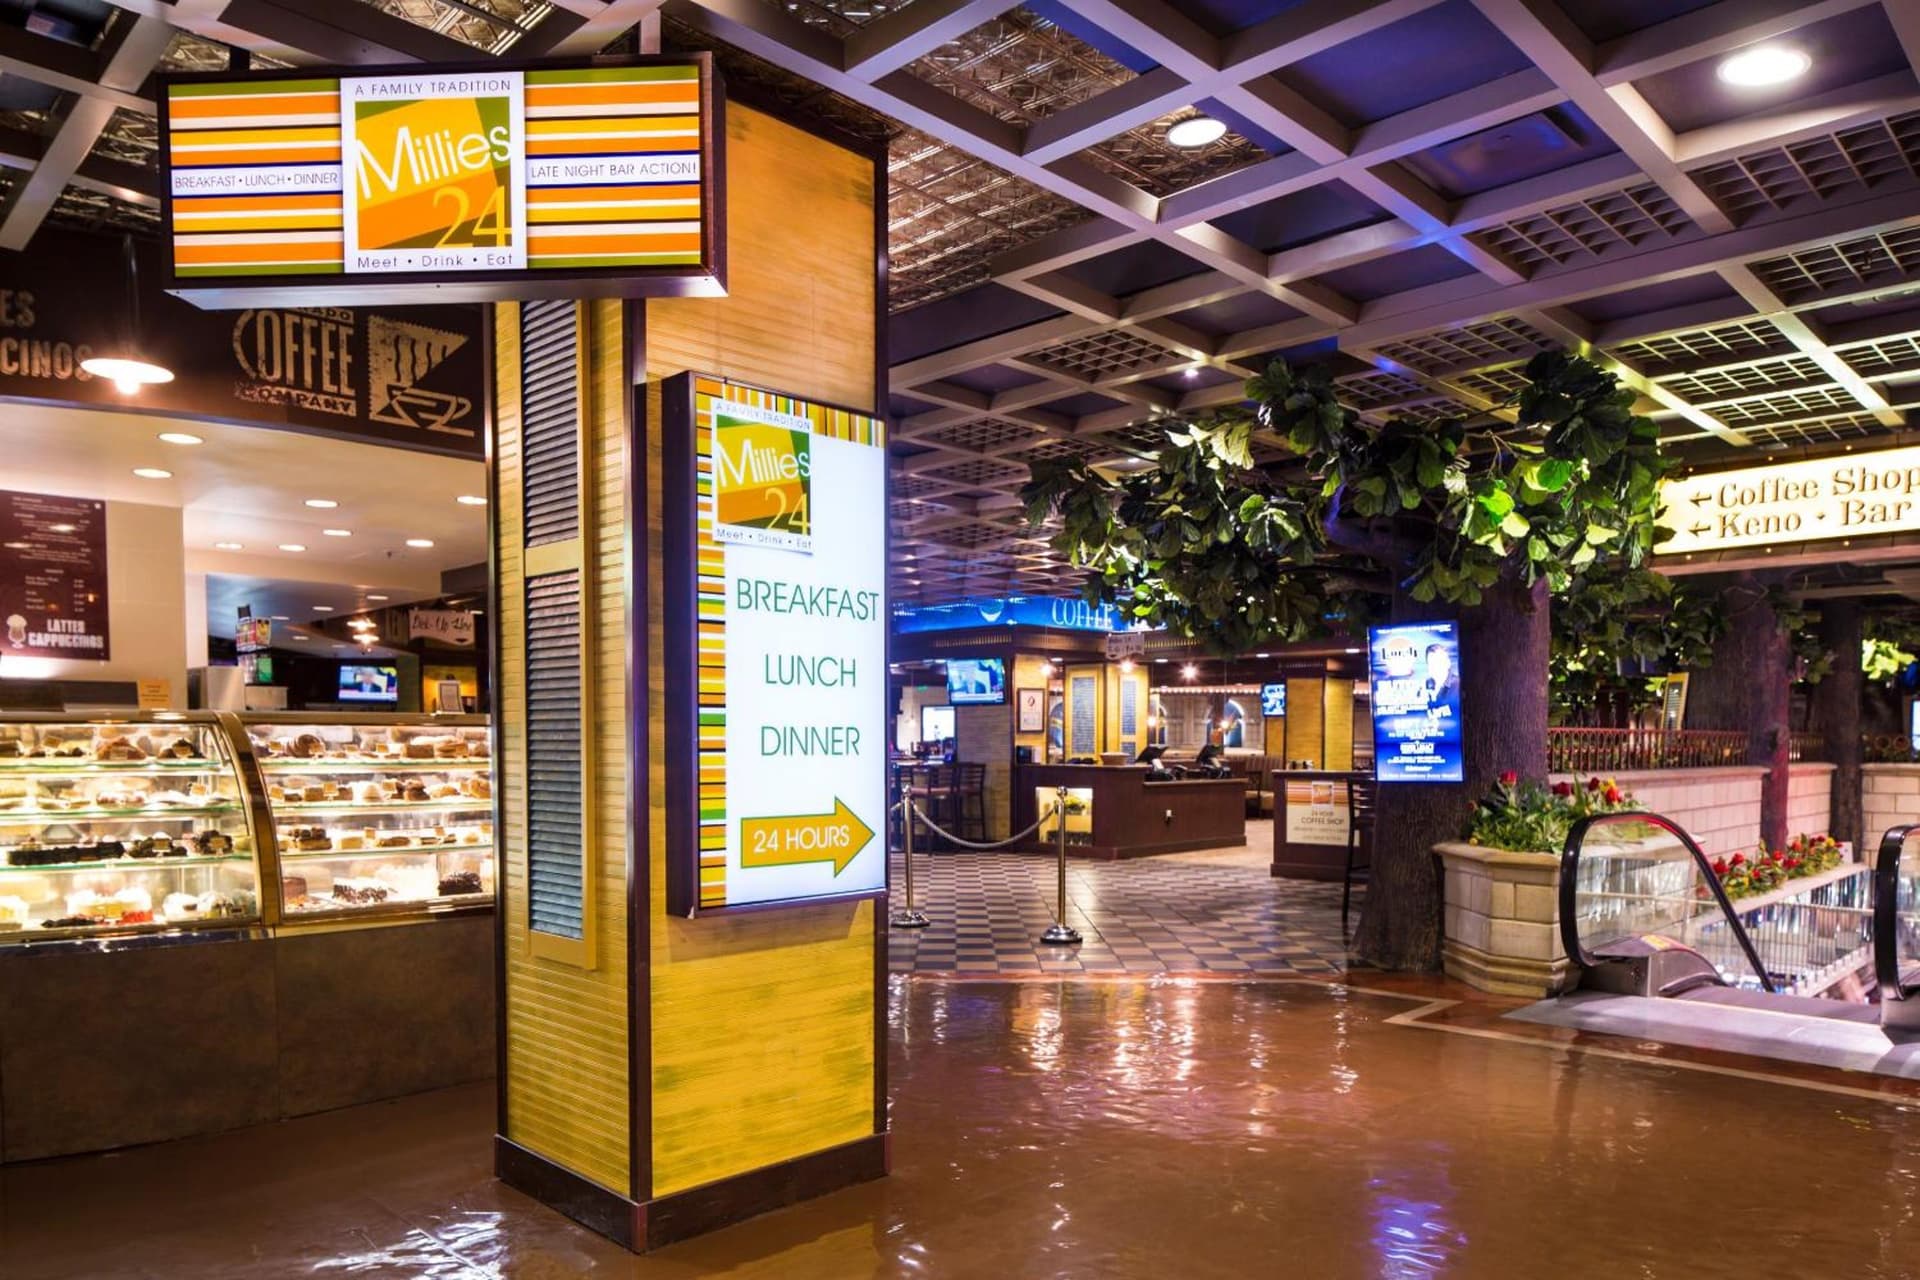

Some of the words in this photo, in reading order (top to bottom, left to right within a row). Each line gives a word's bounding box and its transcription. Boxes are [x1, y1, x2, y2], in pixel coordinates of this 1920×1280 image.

[354, 83, 365, 96] A
[371, 82, 424, 95] FAMILY
[429, 79, 512, 93] TRADITION
[355, 125, 512, 200] Millies
[531, 165, 560, 179] LATE
[564, 164, 605, 178] NIGHT
[609, 163, 635, 176] BAR
[639, 162, 697, 176] ACTION!
[174, 175, 236, 189] BREAKFAST
[244, 173, 286, 187] LUNCH
[293, 172, 339, 185] DINNER
[433, 184, 513, 249] 24
[357, 256, 398, 269] Meet
[421, 255, 464, 268] Drink
[487, 253, 513, 266] Eat
[233, 308, 356, 396] COFFEE
[243, 385, 353, 413] COMPANY
[715, 437, 811, 489] Millies
[1718, 477, 1817, 508] Coffee
[1830, 465, 1920, 497] Shop
[764, 487, 811, 535] 24
[1718, 511, 1802, 539] Keno
[1840, 498, 1912, 527] Bar
[716, 528, 744, 540] Meet
[758, 532, 783, 545] Drink
[796, 536, 812, 550] Eat
[736, 578, 880, 622] BREAKFAST
[764, 653, 857, 688] LUNCH
[760, 725, 861, 758] DINNER
[752, 828, 779, 855] 24
[785, 823, 851, 853] HOURS
